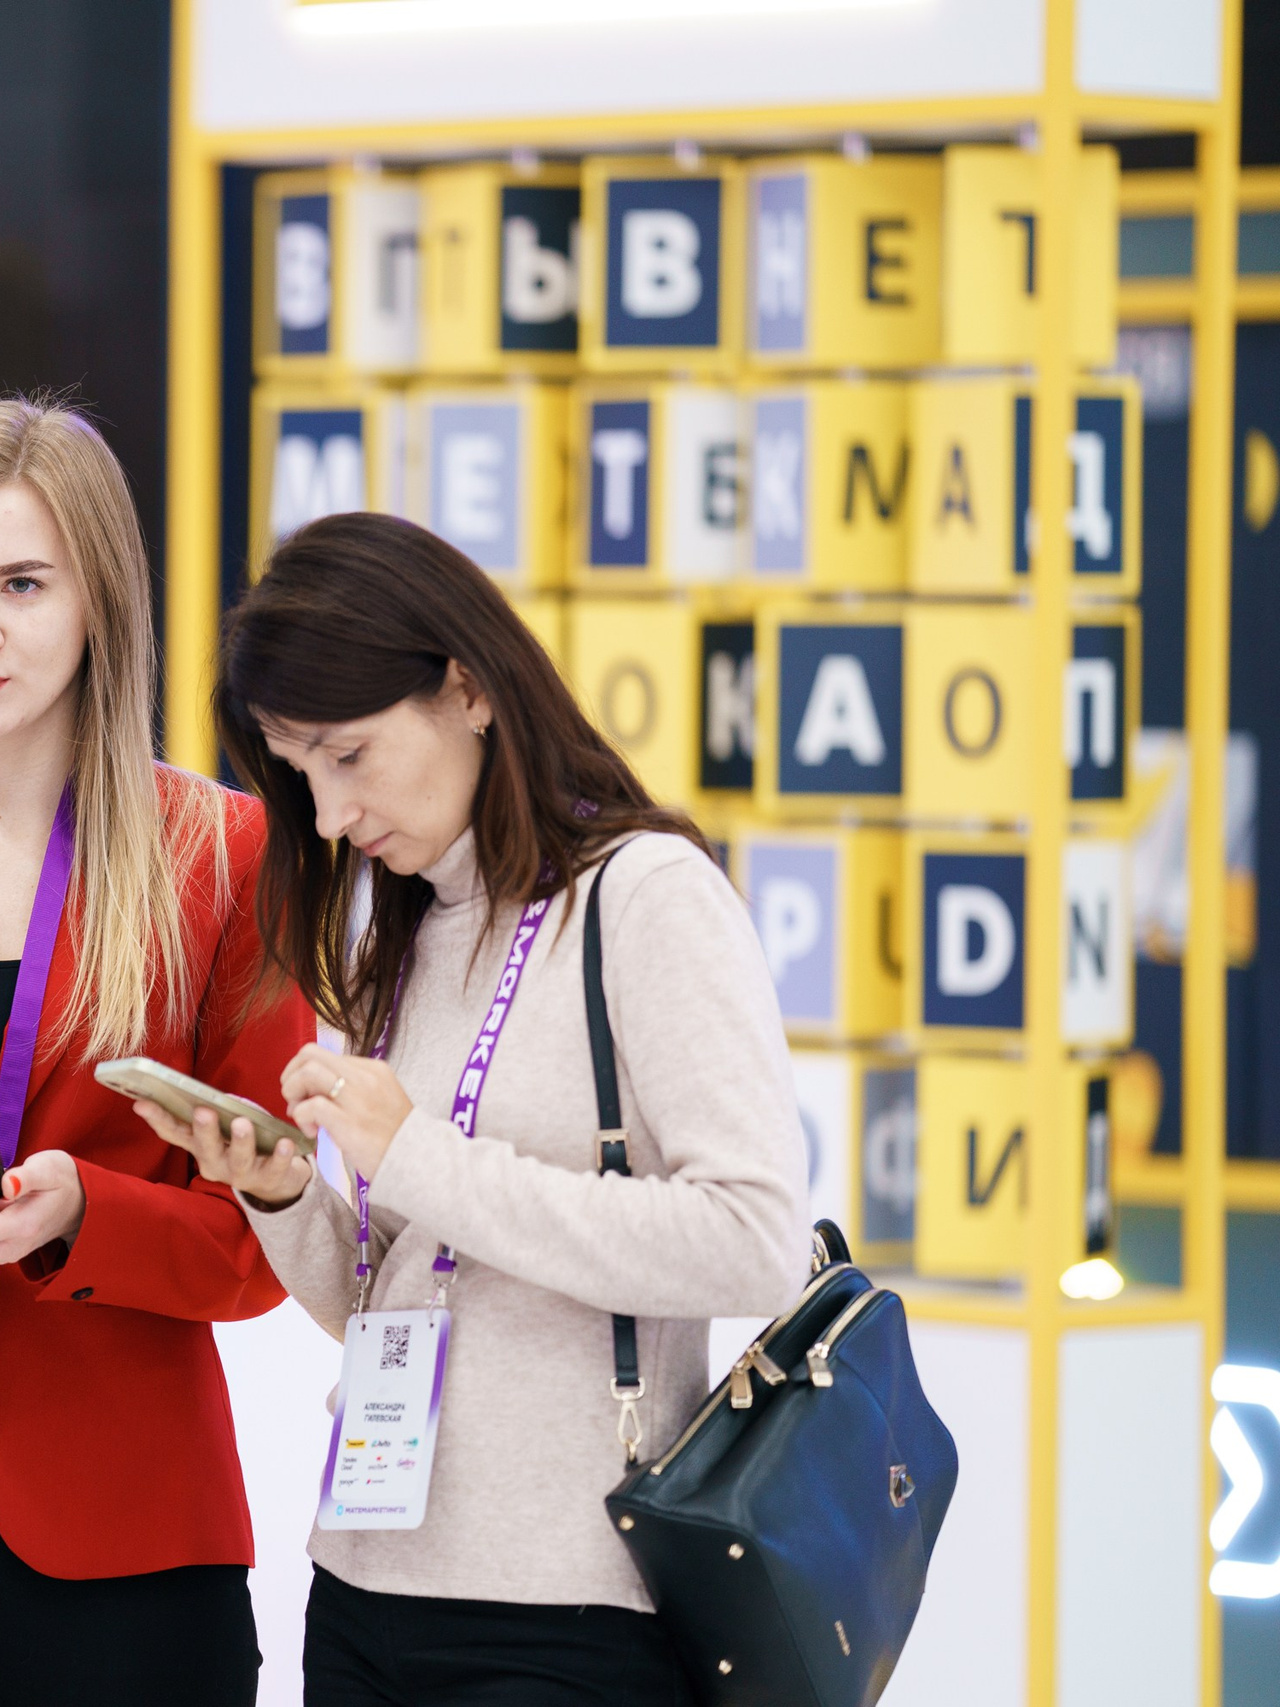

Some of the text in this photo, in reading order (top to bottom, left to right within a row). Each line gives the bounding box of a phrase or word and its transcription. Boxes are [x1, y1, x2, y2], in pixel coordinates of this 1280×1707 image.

[622, 208, 702, 318] В
[863, 216, 913, 306] Е
[442, 433, 505, 542] Е
[593, 429, 647, 538] Т
[795, 653, 886, 766] А
[936, 884, 1016, 997] D
